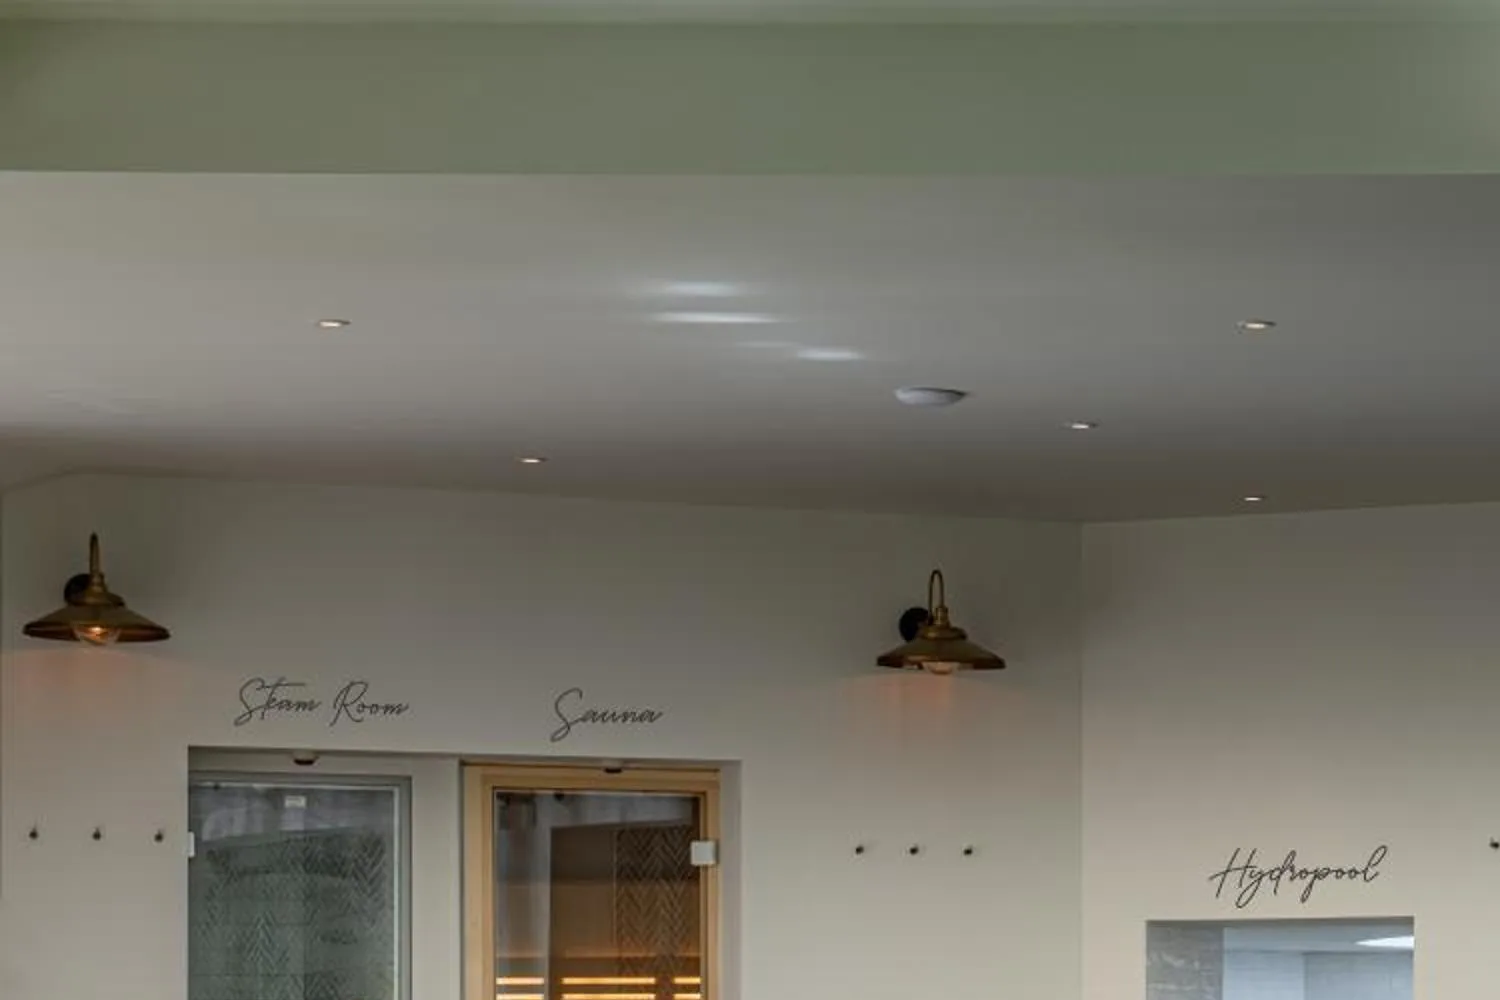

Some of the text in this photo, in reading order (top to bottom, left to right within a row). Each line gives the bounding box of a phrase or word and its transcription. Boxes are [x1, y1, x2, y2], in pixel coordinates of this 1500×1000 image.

[234, 677, 409, 727] Steam Room
[550, 687, 663, 742] Sauna
[1208, 845, 1388, 908] Hydropool
